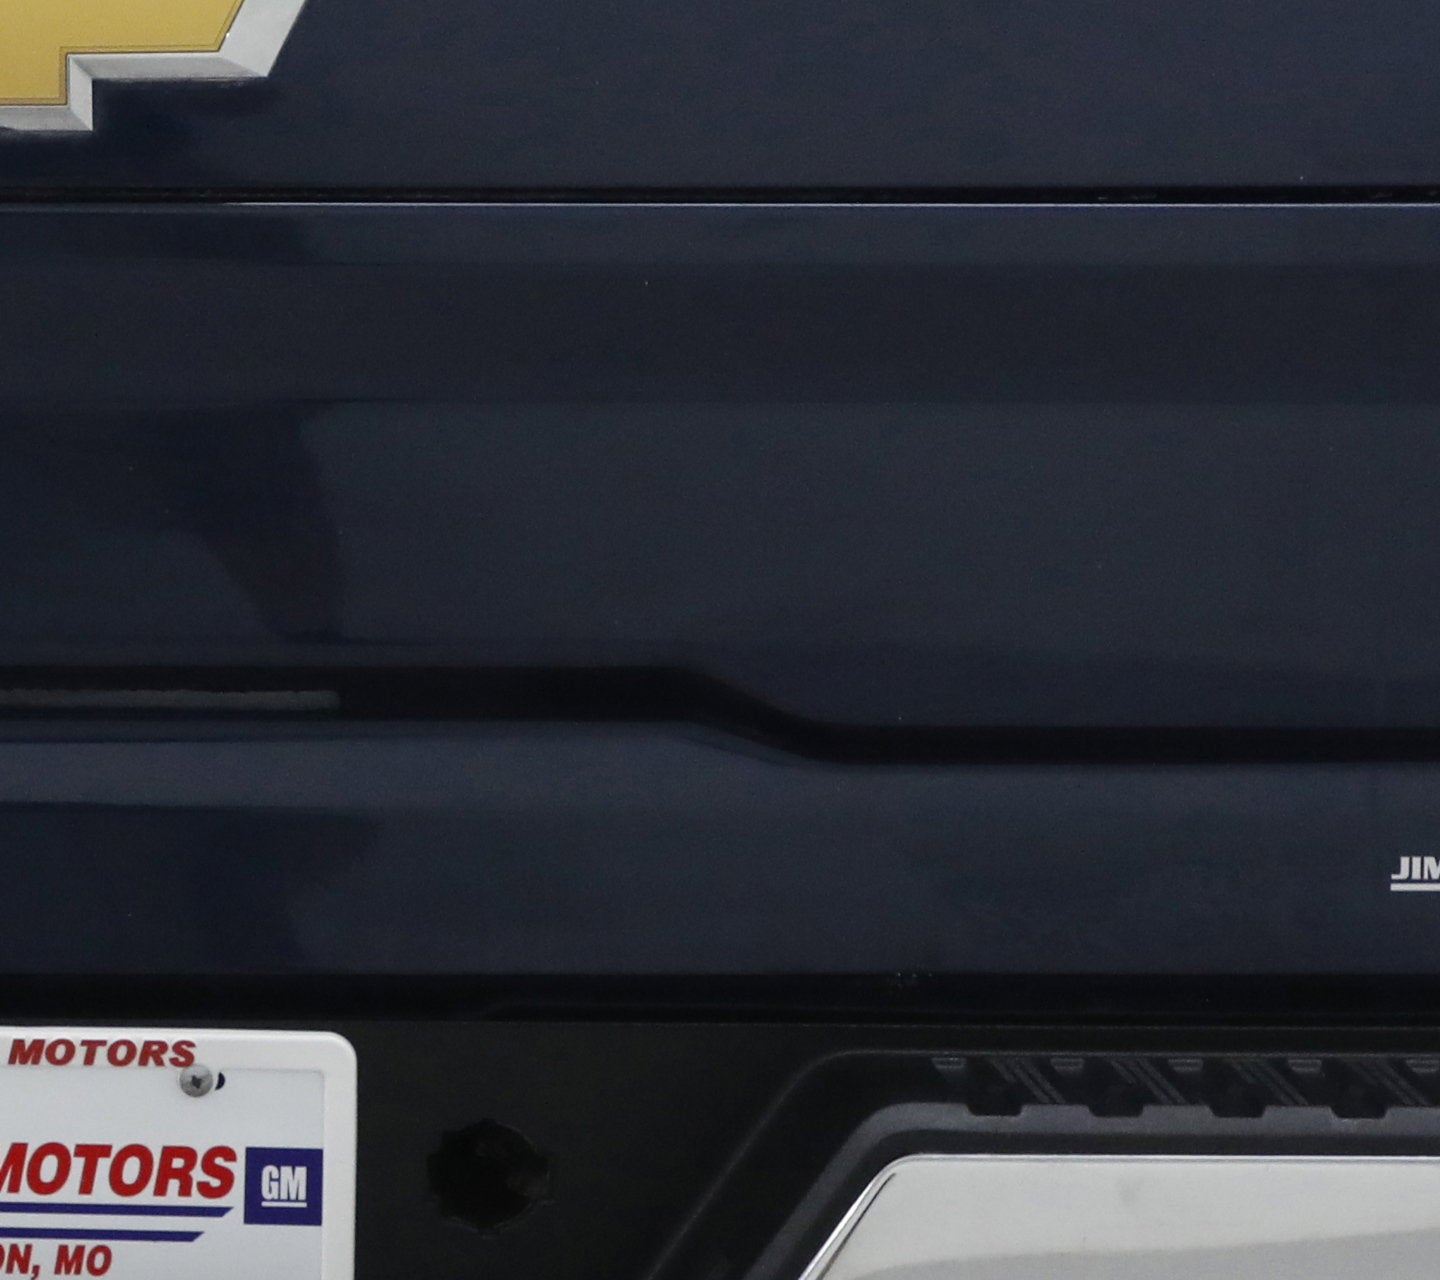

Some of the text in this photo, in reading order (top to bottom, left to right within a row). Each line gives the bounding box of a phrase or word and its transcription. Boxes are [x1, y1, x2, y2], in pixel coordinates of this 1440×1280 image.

[7, 1038, 197, 1068] MOTORS
[261, 1165, 308, 1201] GM
[54, 1245, 112, 1276] MO
